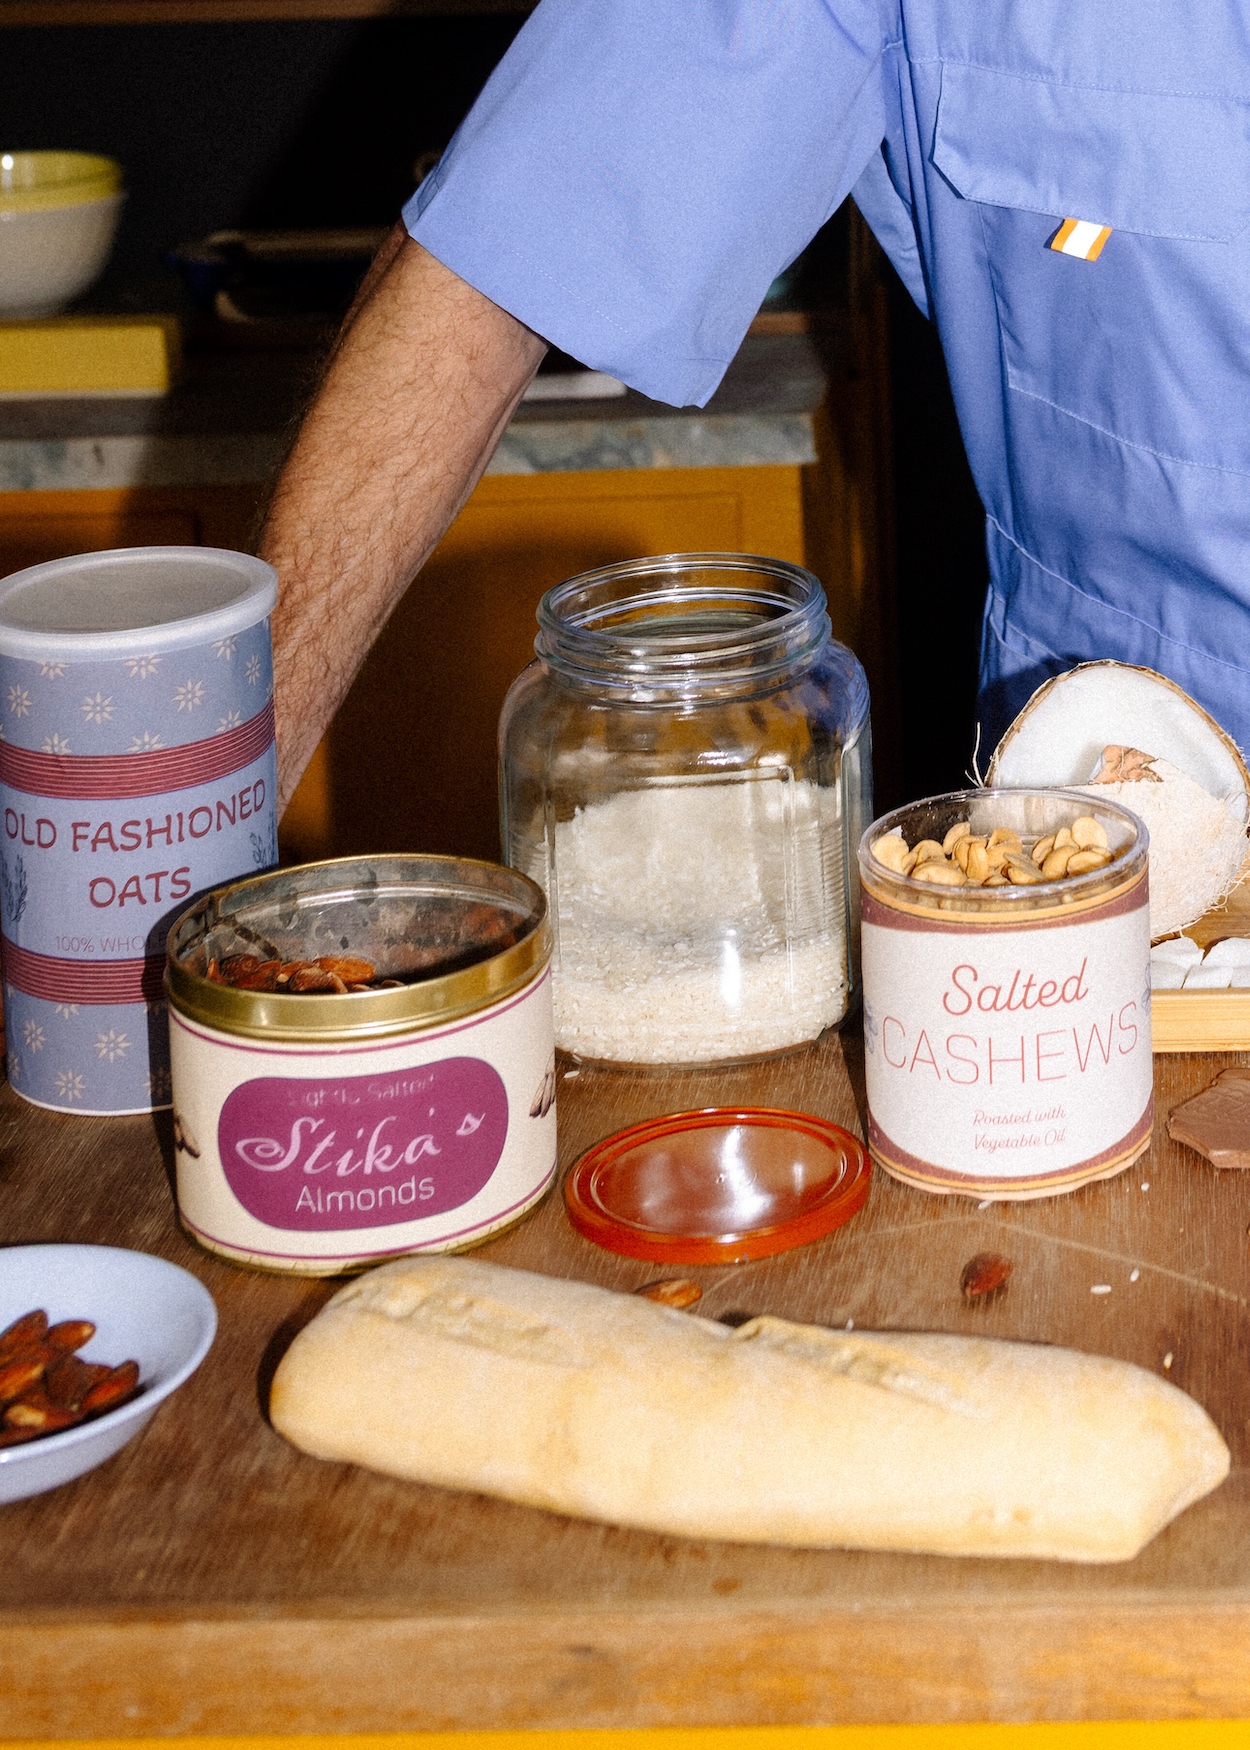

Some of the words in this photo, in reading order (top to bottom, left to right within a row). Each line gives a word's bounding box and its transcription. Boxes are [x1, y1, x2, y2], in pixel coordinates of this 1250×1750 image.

[5, 807, 58, 849] OLD
[71, 779, 266, 853] FASHIONED
[89, 866, 192, 908] OATS
[55, 935, 95, 953] 100%
[942, 957, 1089, 1016] Salted
[882, 1001, 1138, 1085] CASHEWS
[972, 1109, 1032, 1127] Roasted
[1034, 1105, 1067, 1122] with
[235, 1106, 486, 1177] Stika's
[973, 1130, 1041, 1155] Vegetable
[1044, 1127, 1067, 1146] Oil
[295, 1175, 435, 1213] Almonds
